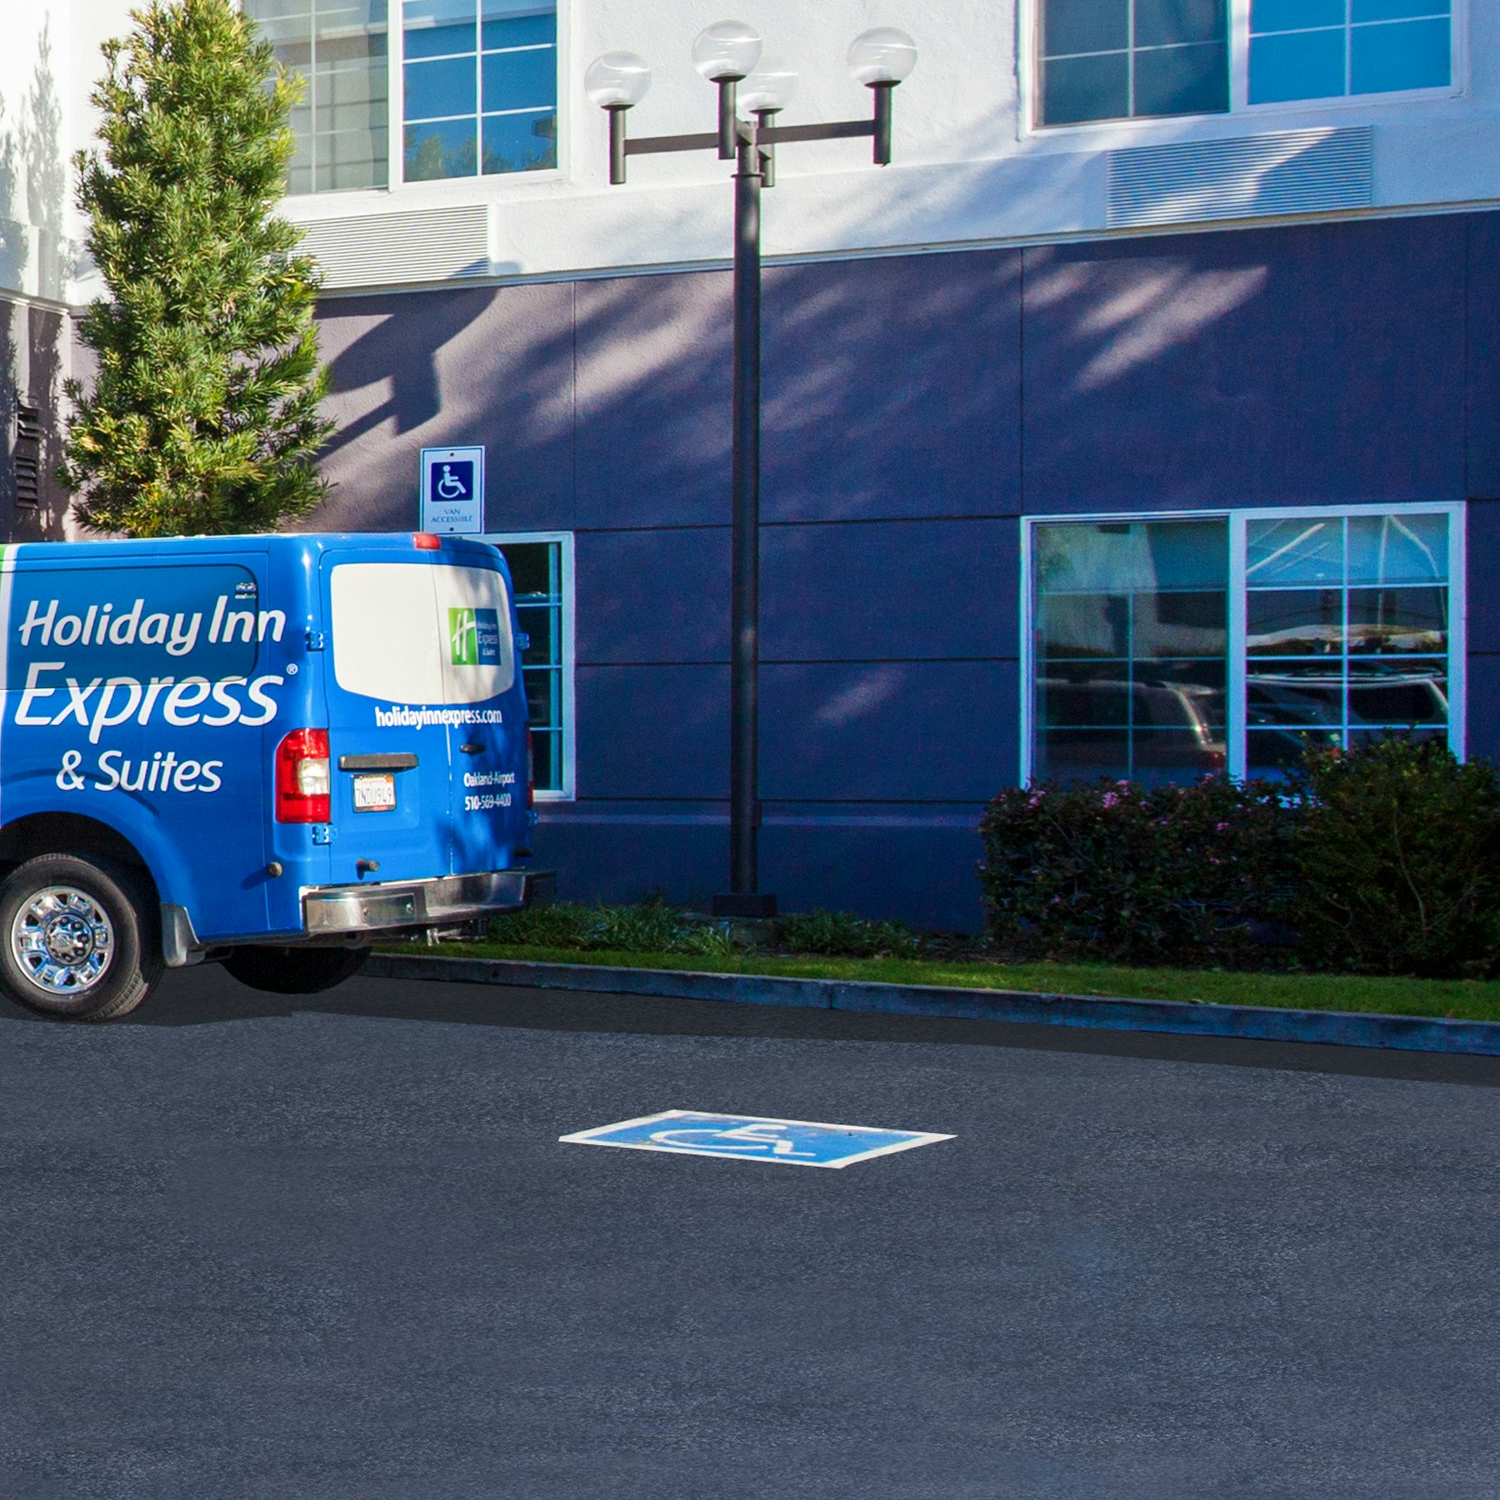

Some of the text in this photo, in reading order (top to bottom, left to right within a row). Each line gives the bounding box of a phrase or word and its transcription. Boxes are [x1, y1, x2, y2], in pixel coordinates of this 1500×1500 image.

[18, 595, 287, 657] Holiday Inn
[14, 661, 285, 745] Express
[375, 705, 502, 731] holidayinnexpress.com
[55, 749, 223, 793] & Suites
[463, 772, 516, 788] Oakland-Airport
[464, 793, 512, 811] 510-569-4400
